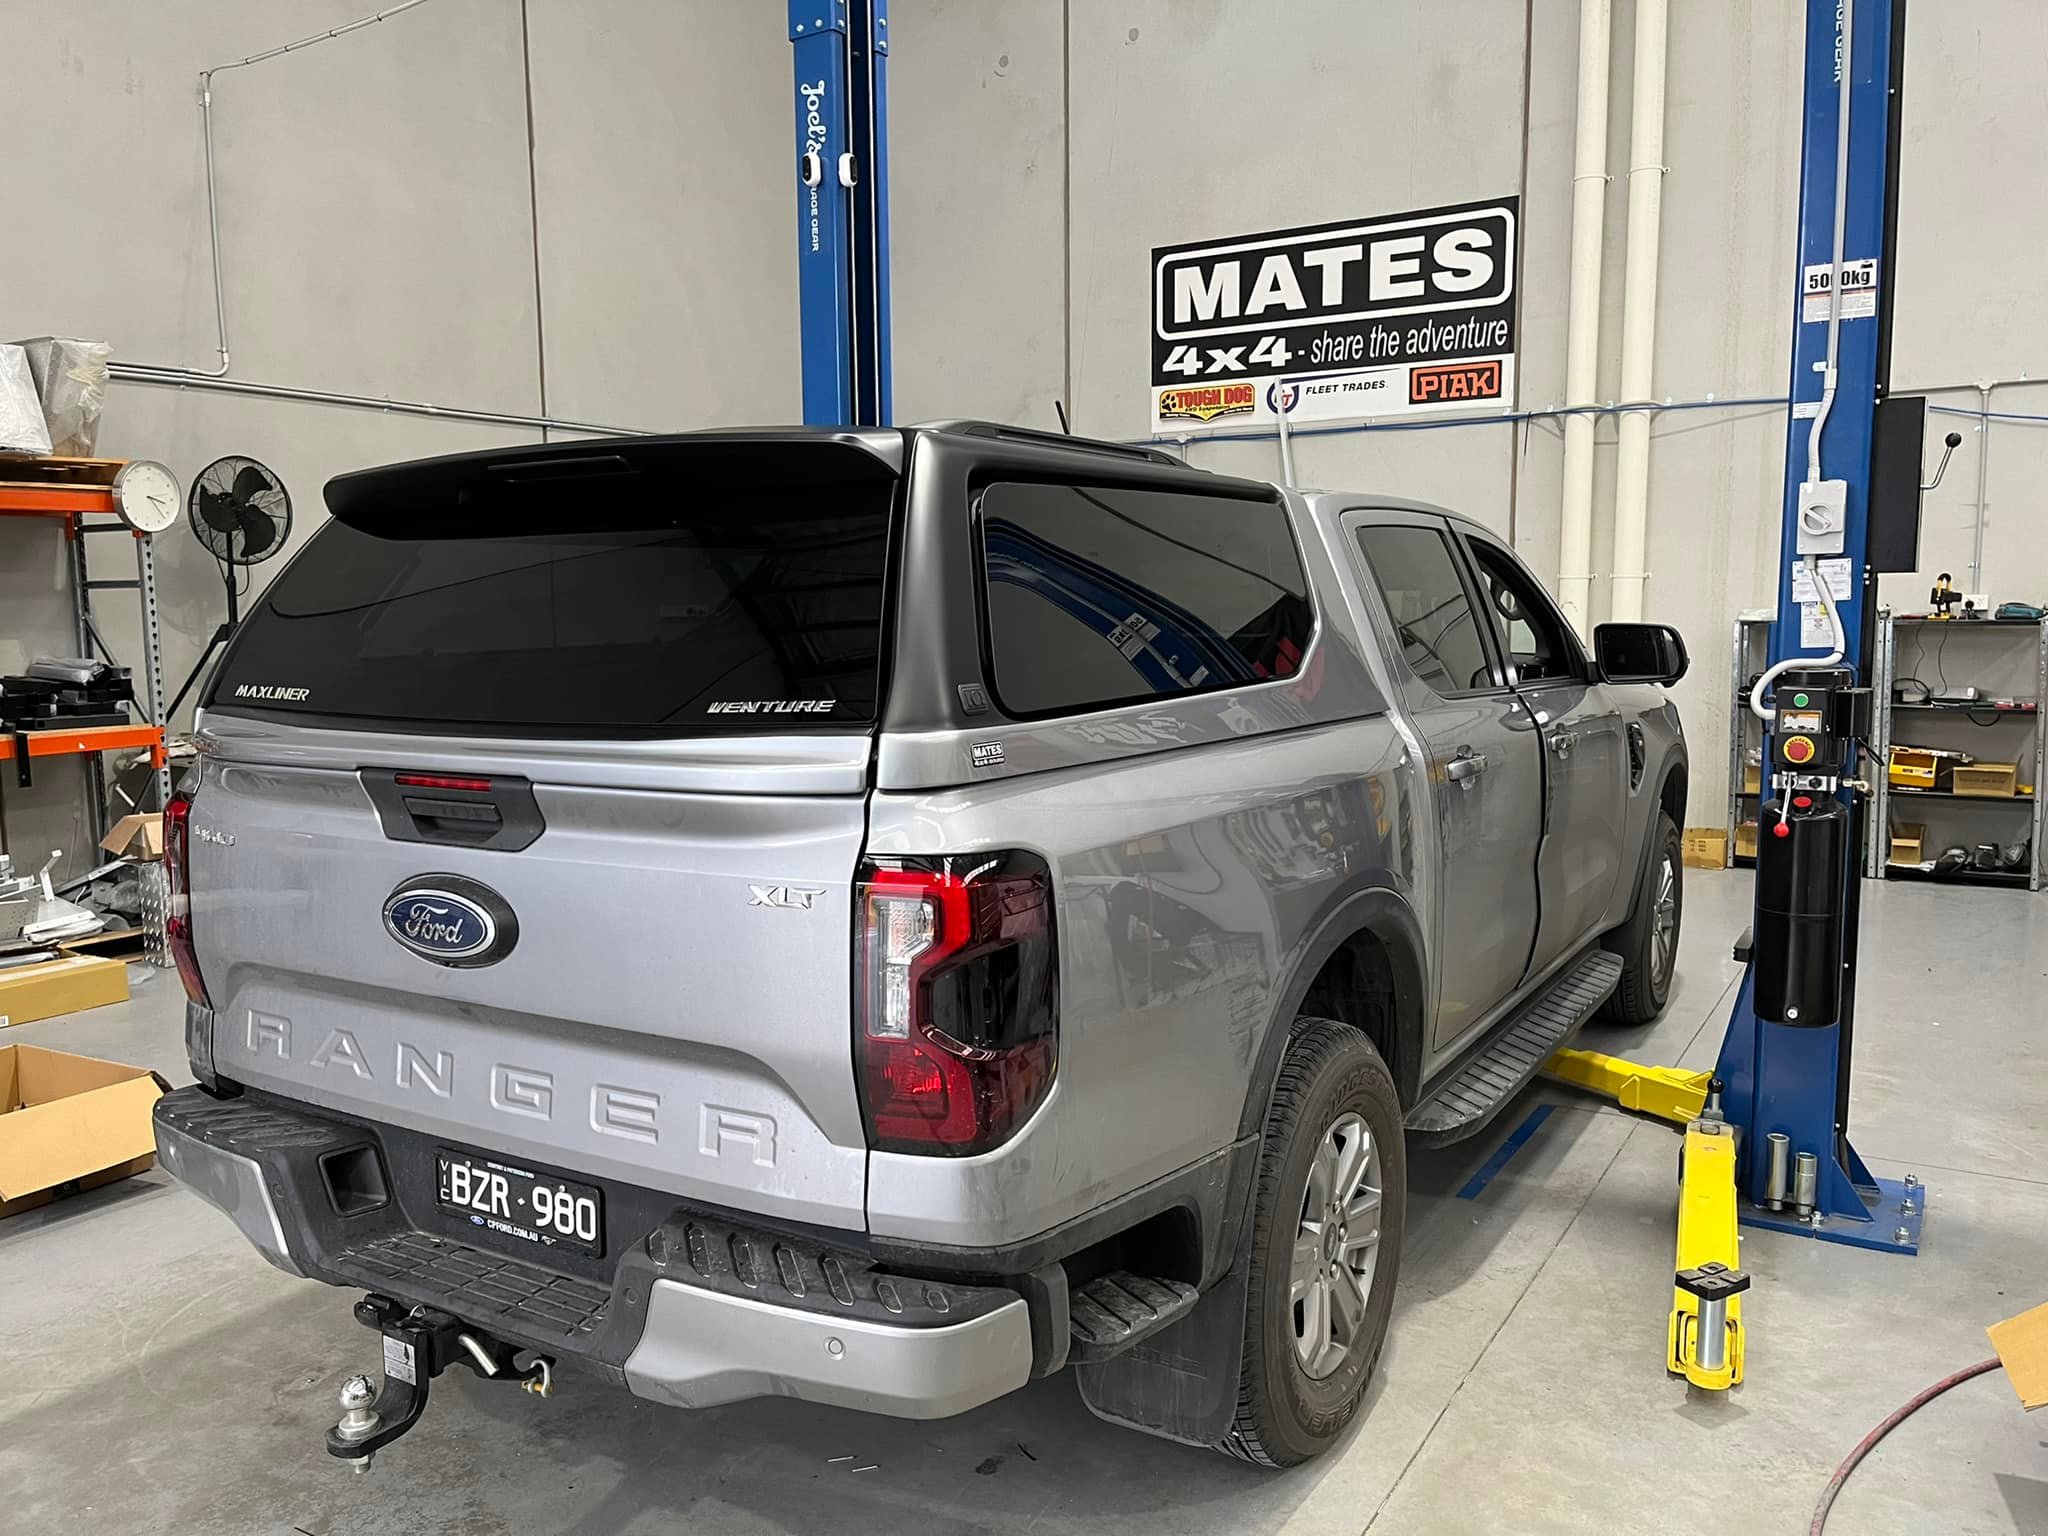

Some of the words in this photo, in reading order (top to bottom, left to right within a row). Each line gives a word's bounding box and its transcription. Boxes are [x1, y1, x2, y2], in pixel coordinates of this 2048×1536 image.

[800, 79, 826, 153] Joel's
[1173, 227, 1494, 324] MATES
[1809, 270, 1871, 290] 500kg
[1162, 335, 1293, 376] 4x4
[1310, 330, 1364, 364] share
[1369, 324, 1400, 358] the
[1406, 315, 1508, 354] adventure
[1176, 389, 1222, 409] TOUGH
[1223, 386, 1253, 405] DOG
[1305, 384, 1339, 395] FLEET
[1342, 380, 1386, 393] TRADES
[1420, 370, 1492, 400] PIAK
[234, 684, 310, 702] MAXLINER
[974, 743, 1003, 758] MATES
[747, 884, 827, 910] XLT
[405, 902, 463, 944] Ford
[245, 1008, 779, 1168] RANGER
[440, 1159, 450, 1201] VIC
[451, 1163, 511, 1218] BZR
[532, 1185, 597, 1242] 980
